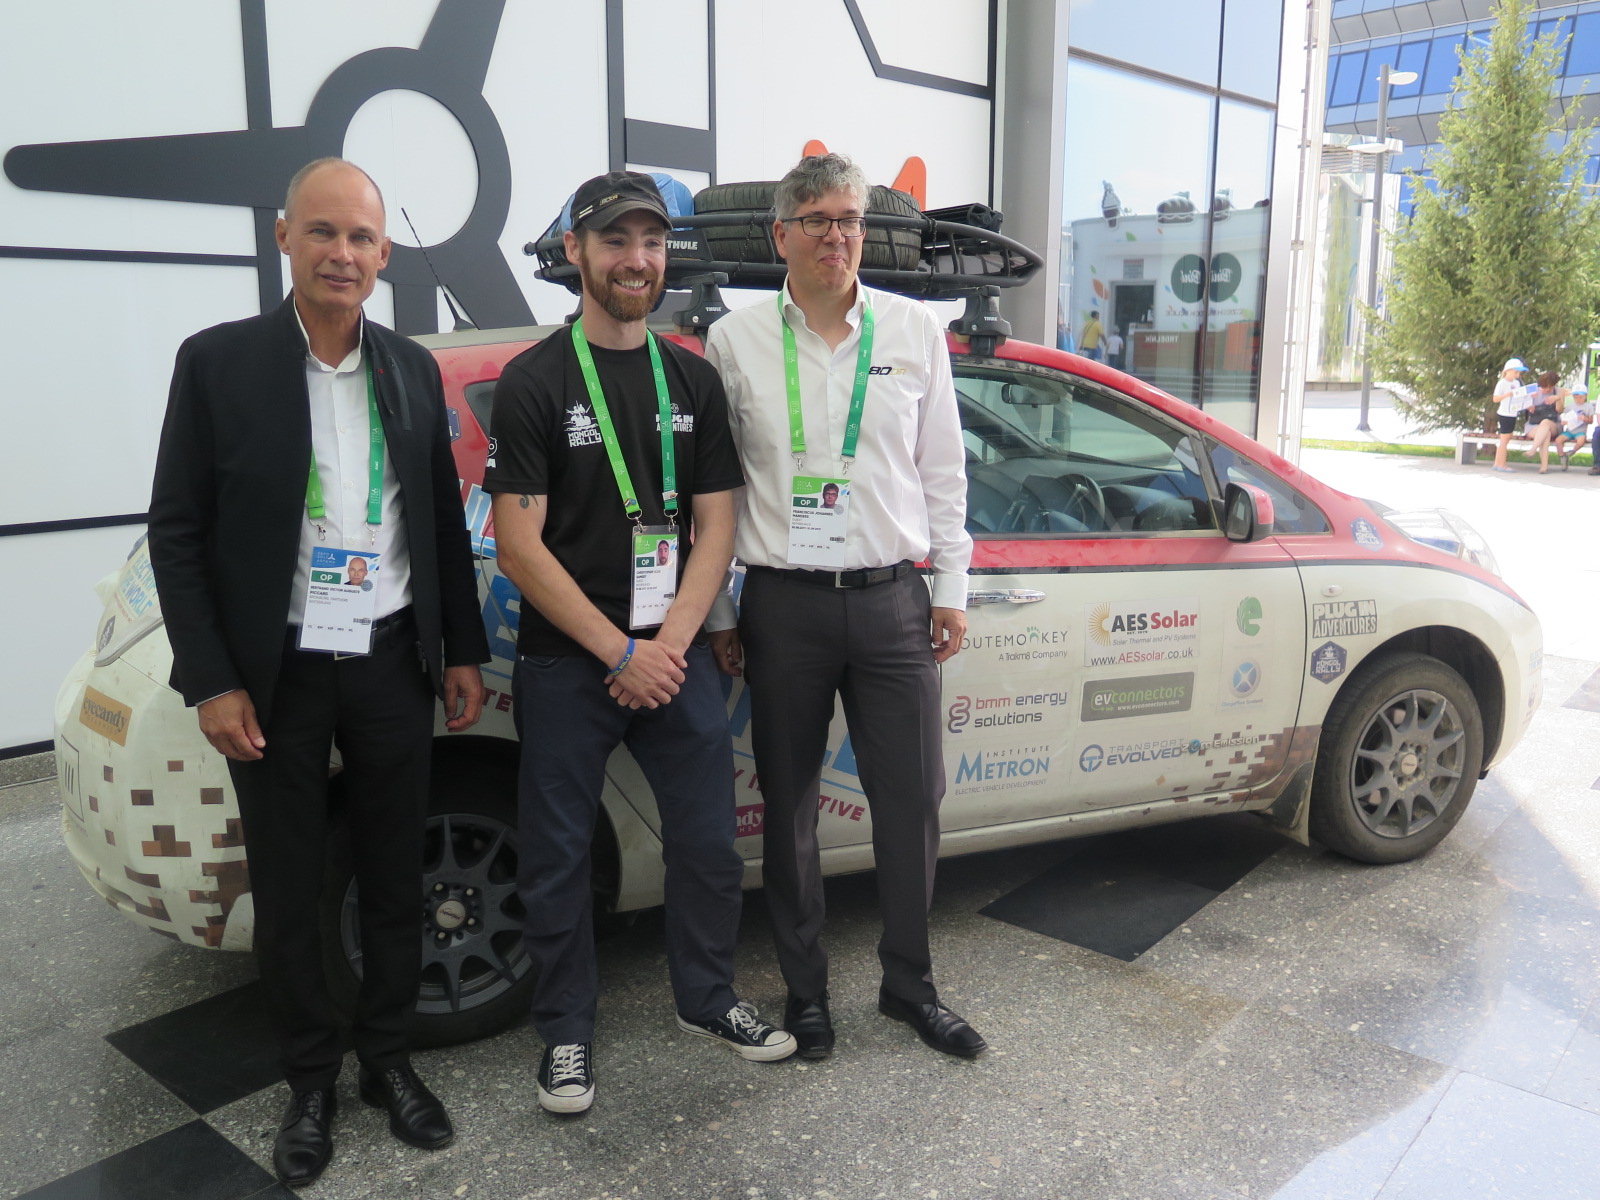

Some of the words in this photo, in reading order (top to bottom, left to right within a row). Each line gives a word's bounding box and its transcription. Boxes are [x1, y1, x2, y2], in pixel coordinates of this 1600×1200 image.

[667, 240, 698, 250] THULE
[568, 429, 598, 440] MONGOL
[570, 433, 602, 447] RALLY
[320, 573, 333, 581] OP
[1313, 601, 1357, 620] PLUG
[1358, 600, 1376, 616] IN
[1111, 613, 1148, 632] AES
[1150, 610, 1197, 629] Solar
[1313, 616, 1376, 637] ADVENTURES
[1129, 637, 1151, 645] Thermal
[999, 653, 1004, 661] A
[1032, 650, 1068, 660] Company
[1090, 647, 1193, 666] www.AESsolar.co.uk
[1315, 665, 1341, 674] RALLY
[975, 697, 1011, 710] bmm
[1015, 692, 1068, 706] energy
[974, 712, 1043, 728] solutions
[986, 745, 1050, 758] INSTITUTE
[1109, 739, 1184, 753] TRANSPORT
[1106, 747, 1183, 765] EVOLVED
[955, 787, 981, 796] ELECTRIC
[982, 784, 1005, 792] VEHICLE
[1006, 779, 1047, 789] DEVELOPMENT
